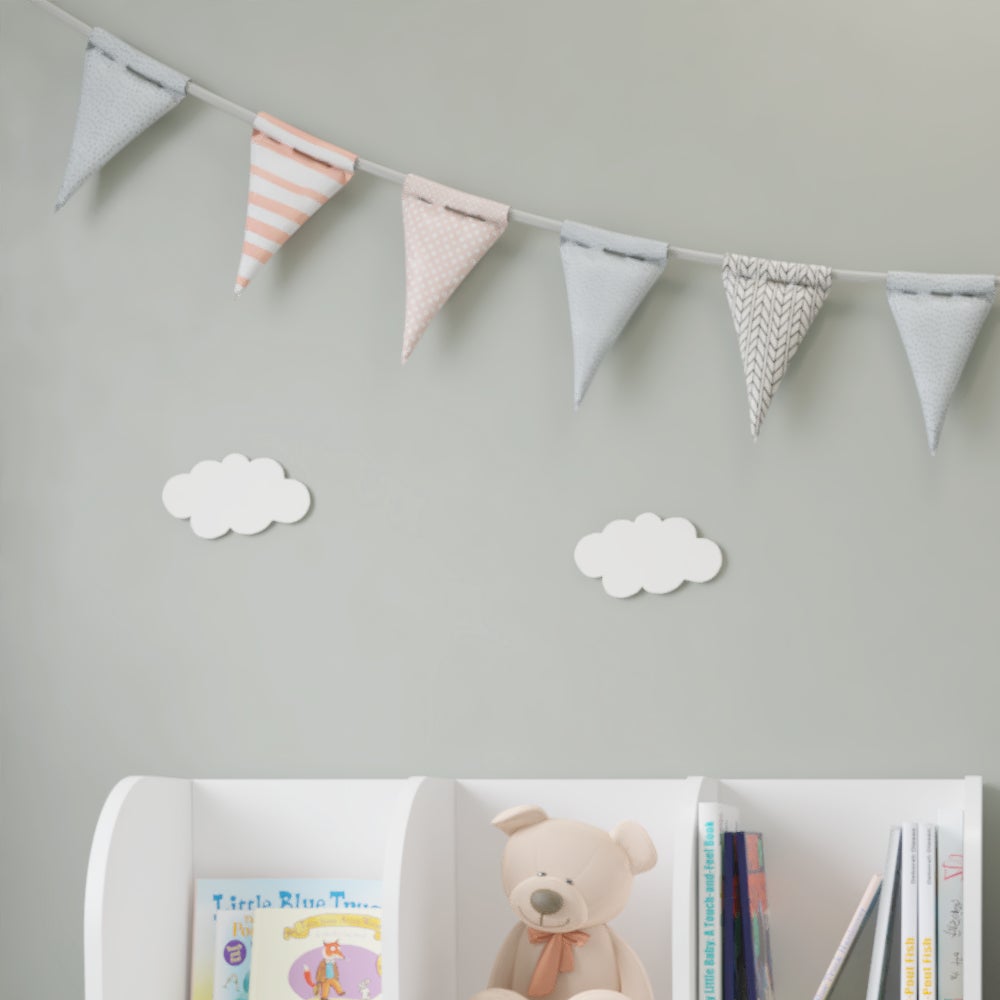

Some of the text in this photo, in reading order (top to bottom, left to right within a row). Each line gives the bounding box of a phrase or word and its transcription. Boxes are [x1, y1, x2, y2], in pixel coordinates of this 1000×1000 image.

[704, 821, 714, 846] Book
[904, 938, 916, 963] Fish
[922, 938, 932, 964] Fish
[703, 968, 714, 994] Little
